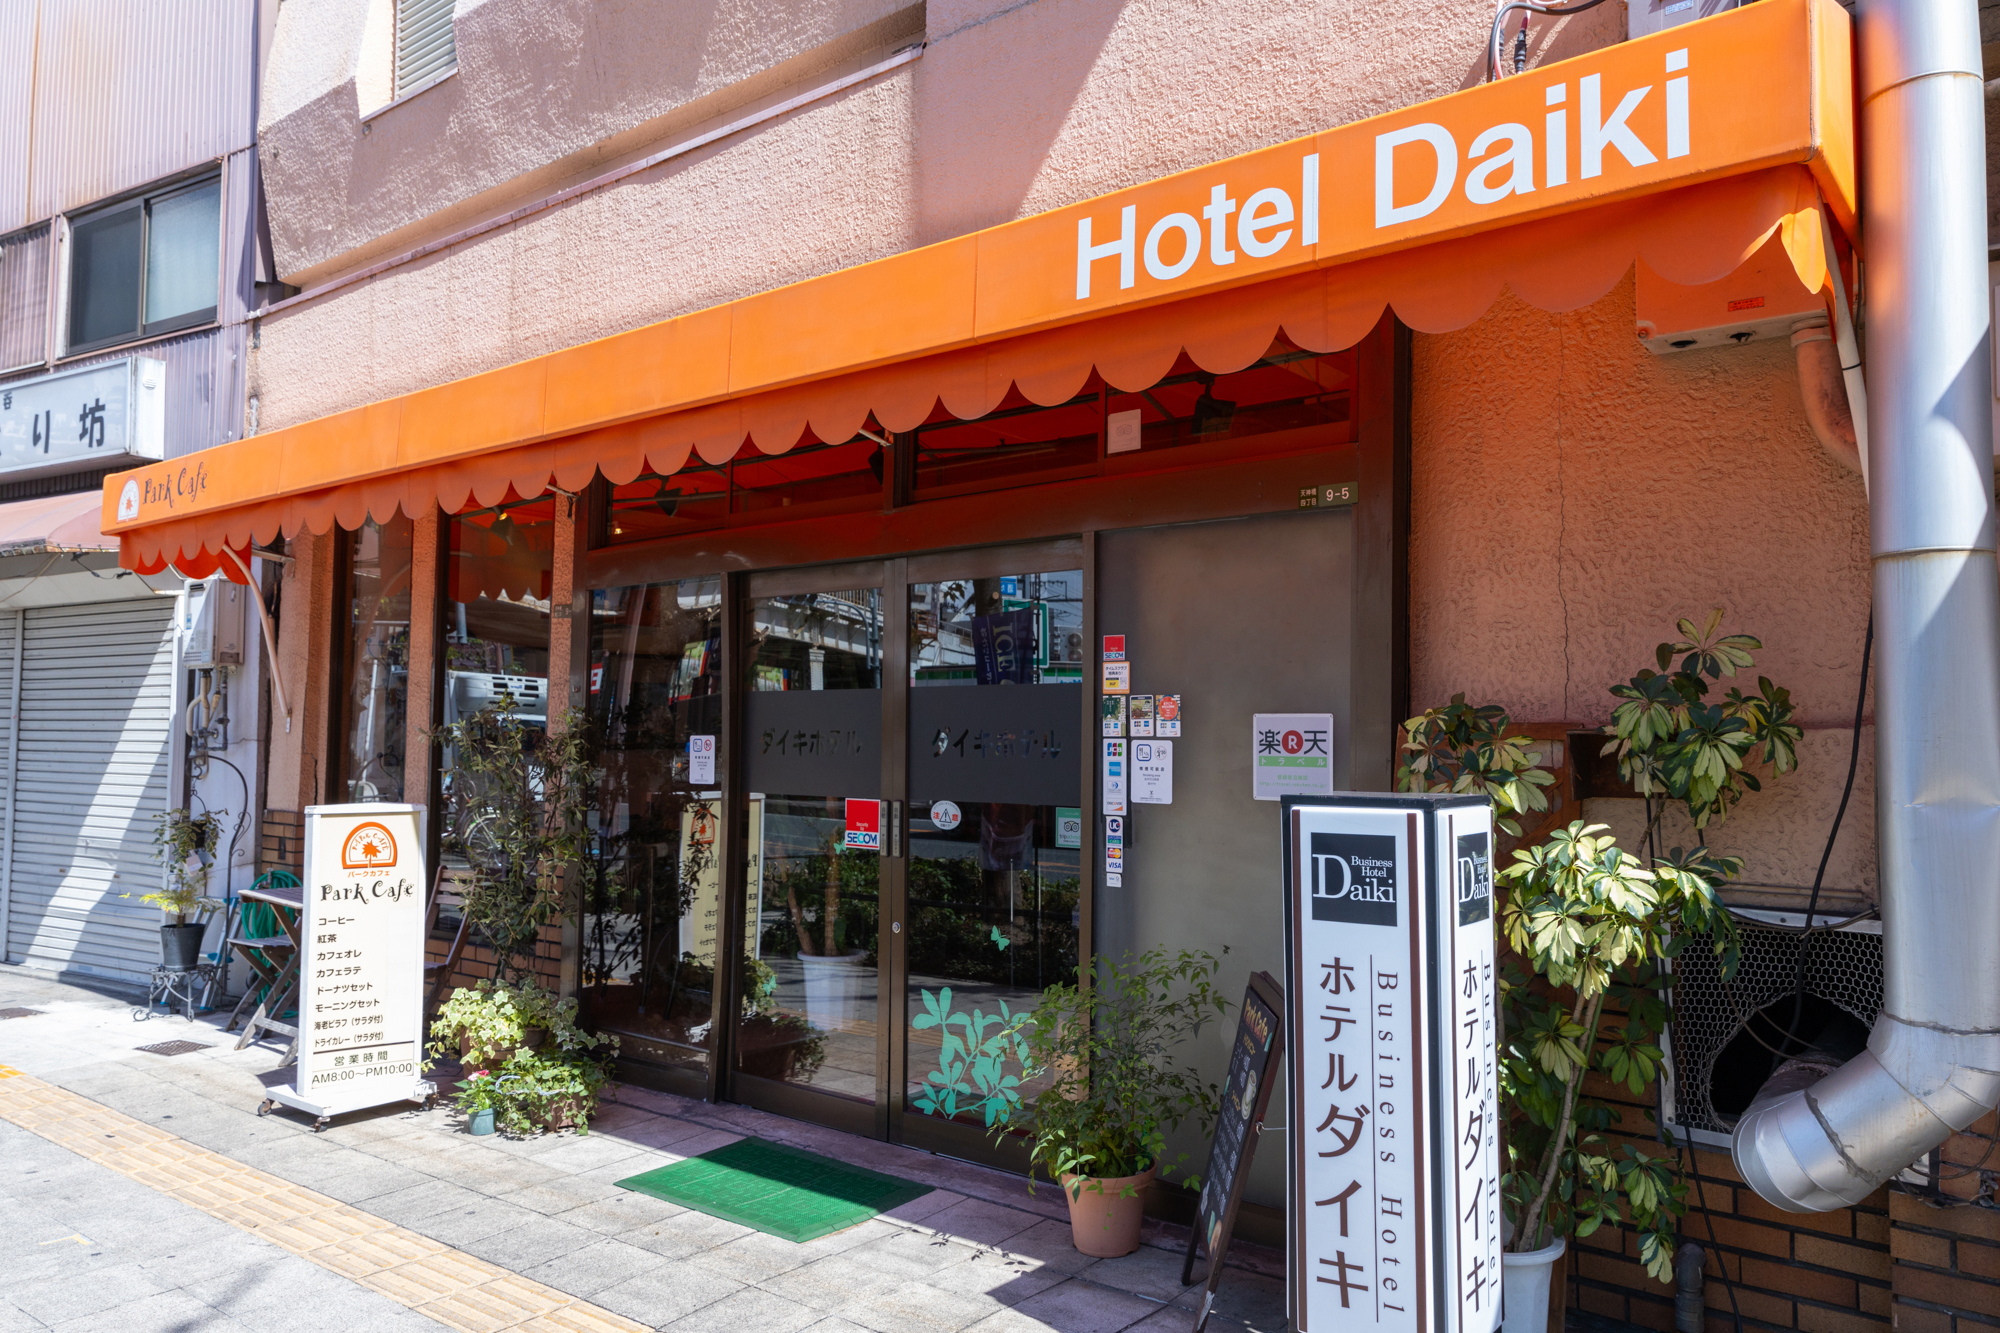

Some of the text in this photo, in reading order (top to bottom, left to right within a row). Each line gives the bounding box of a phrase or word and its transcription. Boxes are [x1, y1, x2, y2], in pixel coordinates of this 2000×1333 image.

[1076, 47, 1690, 300] Hotel Daiki
[0, 398, 106, 455] り坊
[143, 462, 209, 508] Park Cafe
[1326, 487, 1350, 501] 9-5
[993, 622, 1016, 672] ICE
[761, 727, 861, 756] ダイキホテル
[932, 726, 1062, 759] ダイキホテル
[1261, 757, 1325, 766] トラベル
[847, 832, 878, 845] SECOM
[1351, 855, 1393, 868] Business
[347, 869, 390, 878] パークカフェ
[1312, 853, 1396, 903] Daiki
[1361, 866, 1387, 878] Hotel
[1458, 857, 1489, 903] Daiki
[320, 883, 369, 905] Park
[318, 916, 355, 926] コーヒー
[317, 933, 337, 944] 紅茶
[317, 949, 362, 961] カフェオレ
[316, 966, 362, 978] カフェラテ
[317, 982, 373, 995] ドーナツセット
[315, 998, 380, 1013] モーニングセット
[334, 1051, 388, 1067] 営業時間
[1314, 956, 1371, 1309] ホテルダイキ
[1483, 963, 1498, 1289] Business Hotel
[1377, 969, 1405, 1312] Business Hotel
[1462, 959, 1487, 1313] ホテルダイキ
